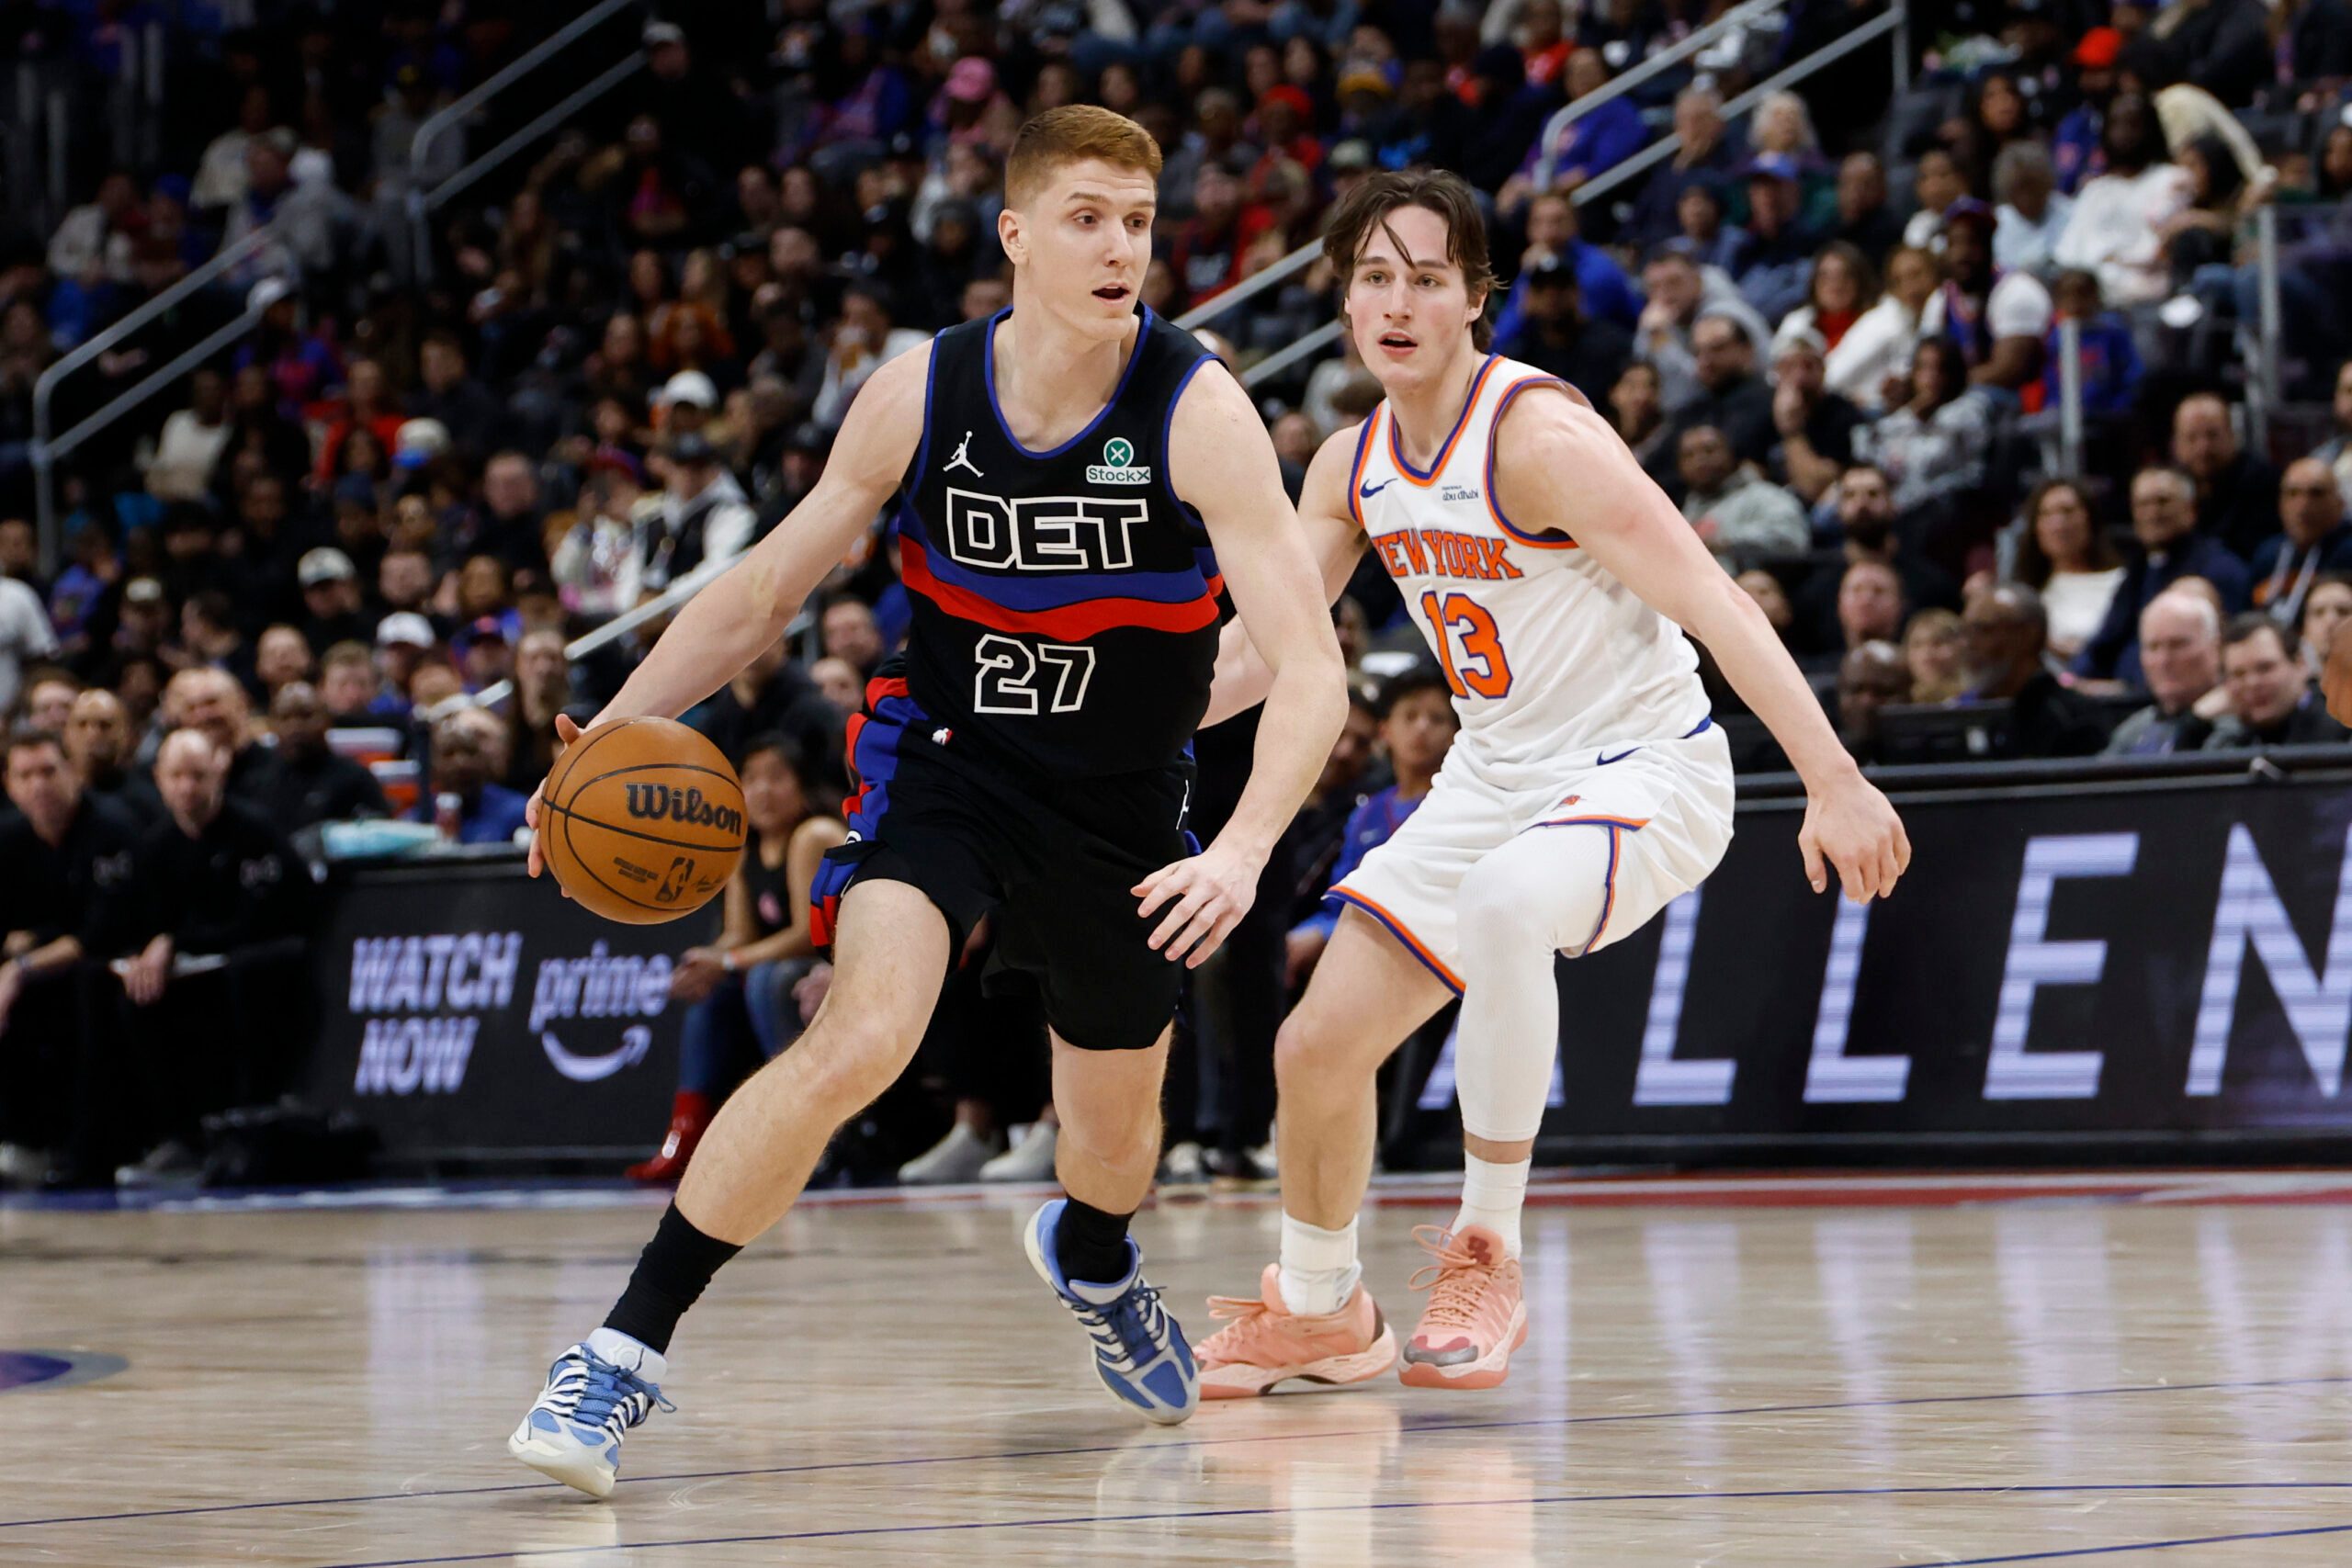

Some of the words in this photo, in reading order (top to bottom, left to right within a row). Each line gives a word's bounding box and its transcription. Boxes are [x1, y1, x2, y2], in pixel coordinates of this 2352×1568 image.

[1088, 468, 1150, 482] StockX
[946, 487, 1148, 570] DET
[1420, 529, 1524, 580] YORK
[974, 634, 1095, 716] 27
[1421, 591, 1513, 699] 13
[625, 783, 742, 837] Wilson
[348, 931, 525, 1011] WATCH
[528, 938, 673, 1033] prime
[1416, 822, 2352, 1110] LLEN
[355, 1016, 481, 1096] NOW
